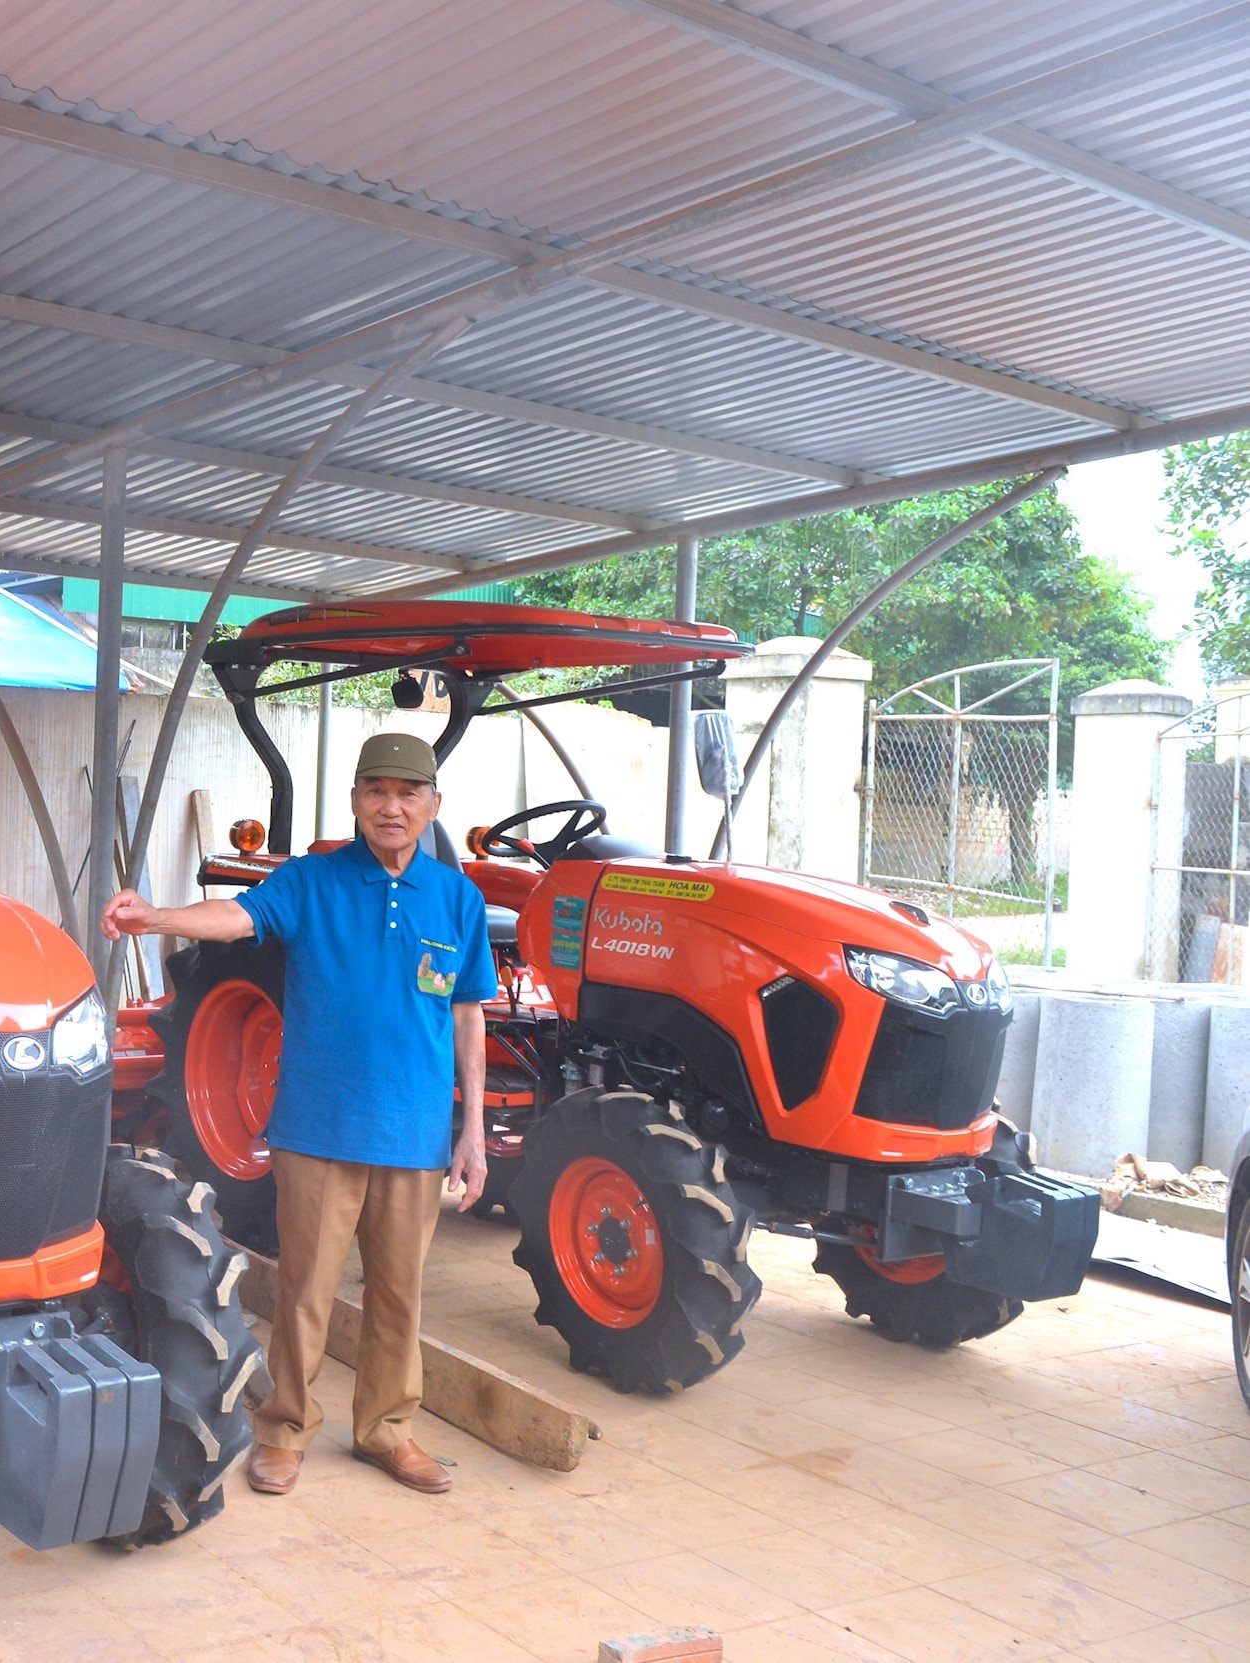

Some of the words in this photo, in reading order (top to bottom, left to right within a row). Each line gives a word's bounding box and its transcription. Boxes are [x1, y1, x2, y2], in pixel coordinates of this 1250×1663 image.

[669, 881, 689, 890] HOA
[691, 883, 709, 892] MAI
[593, 907, 663, 936] Kubota
[591, 936, 675, 960] L4018VN
